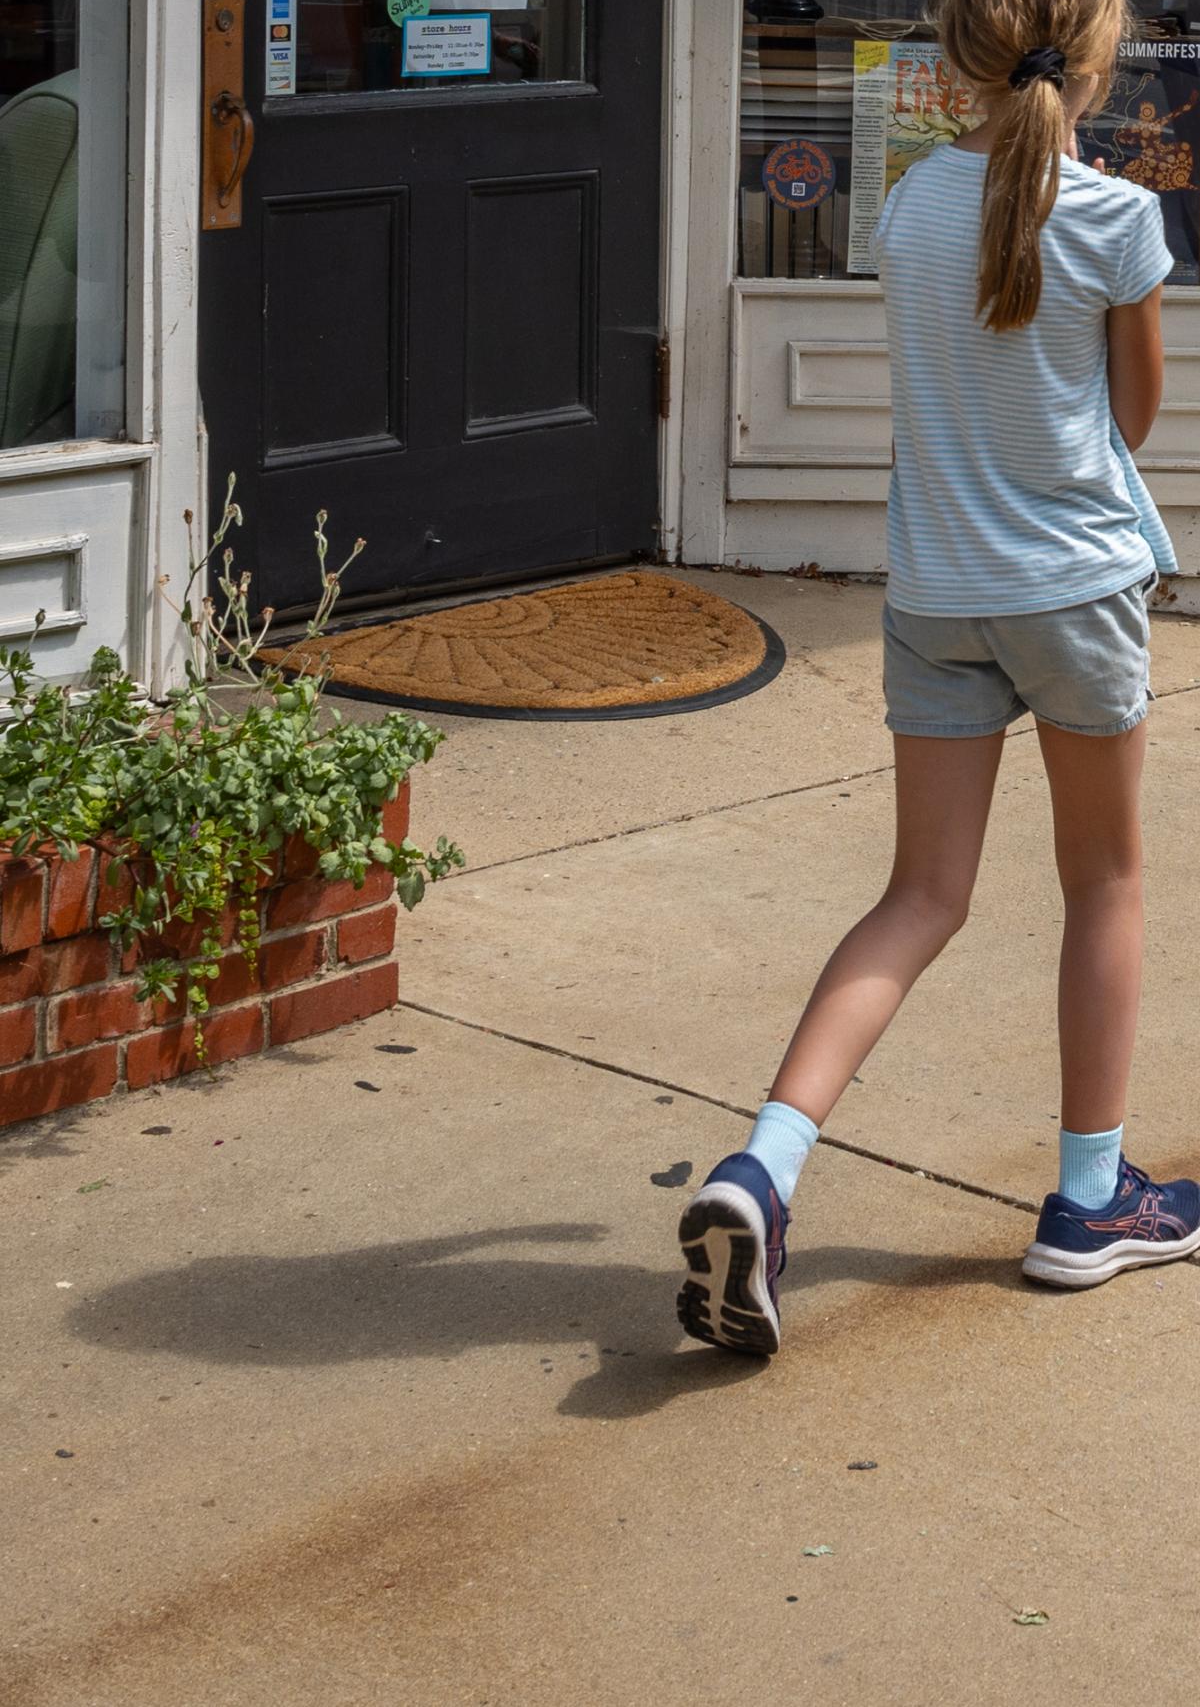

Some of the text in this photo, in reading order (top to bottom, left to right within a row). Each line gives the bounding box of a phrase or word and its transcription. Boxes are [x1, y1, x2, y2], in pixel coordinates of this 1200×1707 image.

[421, 23, 472, 33] store hours
[272, 53, 289, 61] VISA
